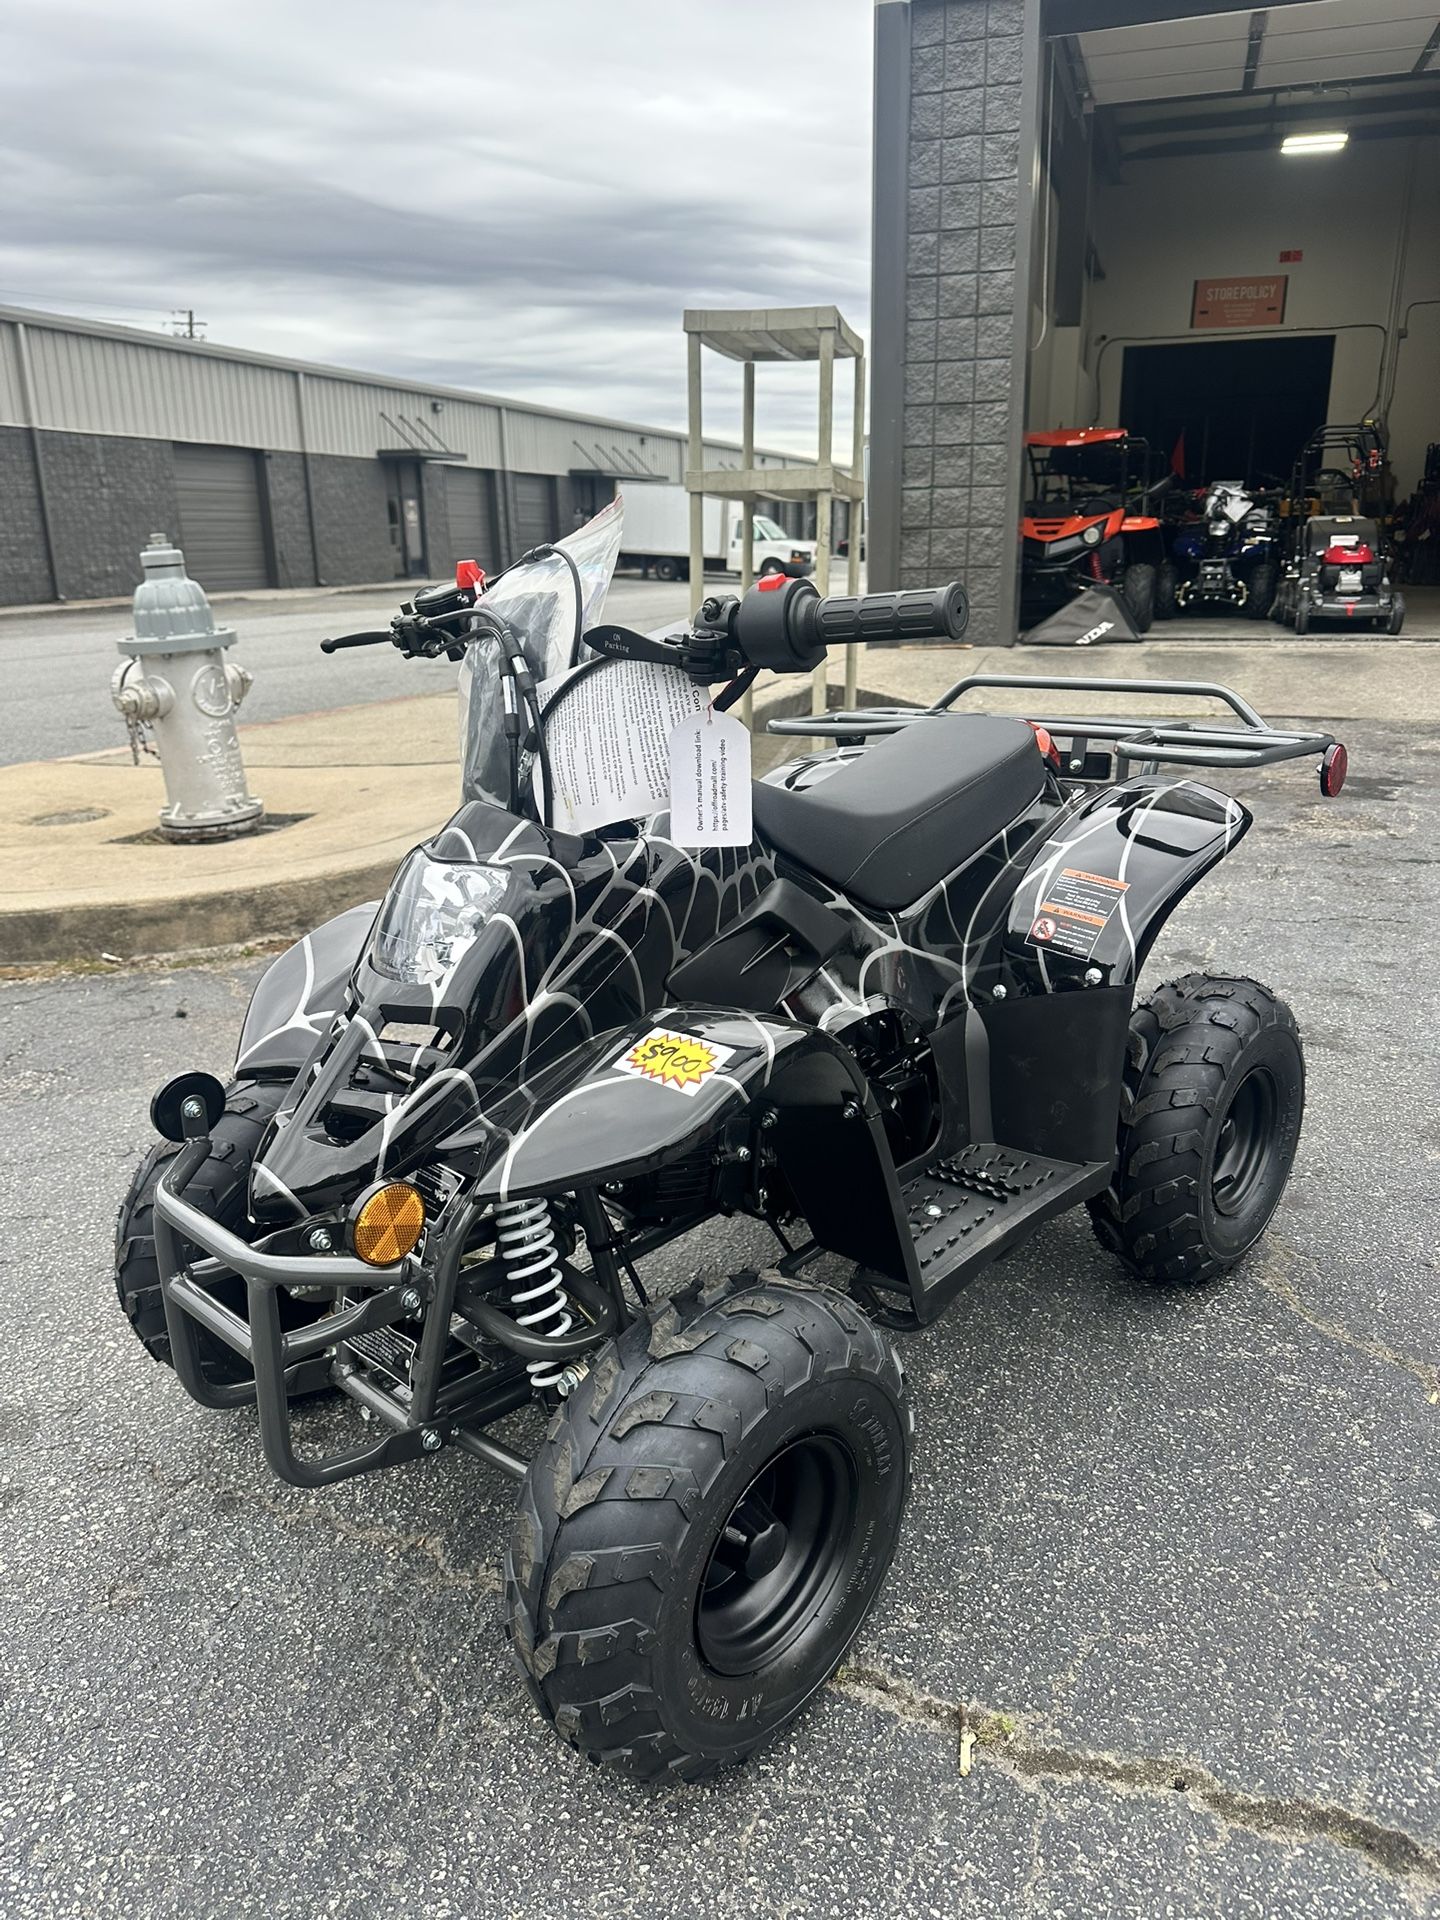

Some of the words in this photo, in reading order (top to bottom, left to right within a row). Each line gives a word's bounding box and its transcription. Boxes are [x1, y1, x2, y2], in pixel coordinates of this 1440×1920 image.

[612, 633, 620, 641] ON
[604, 640, 630, 653] Parking
[694, 744, 702, 778] download
[655, 762, 663, 780] speed
[642, 1043, 702, 1072] $900
